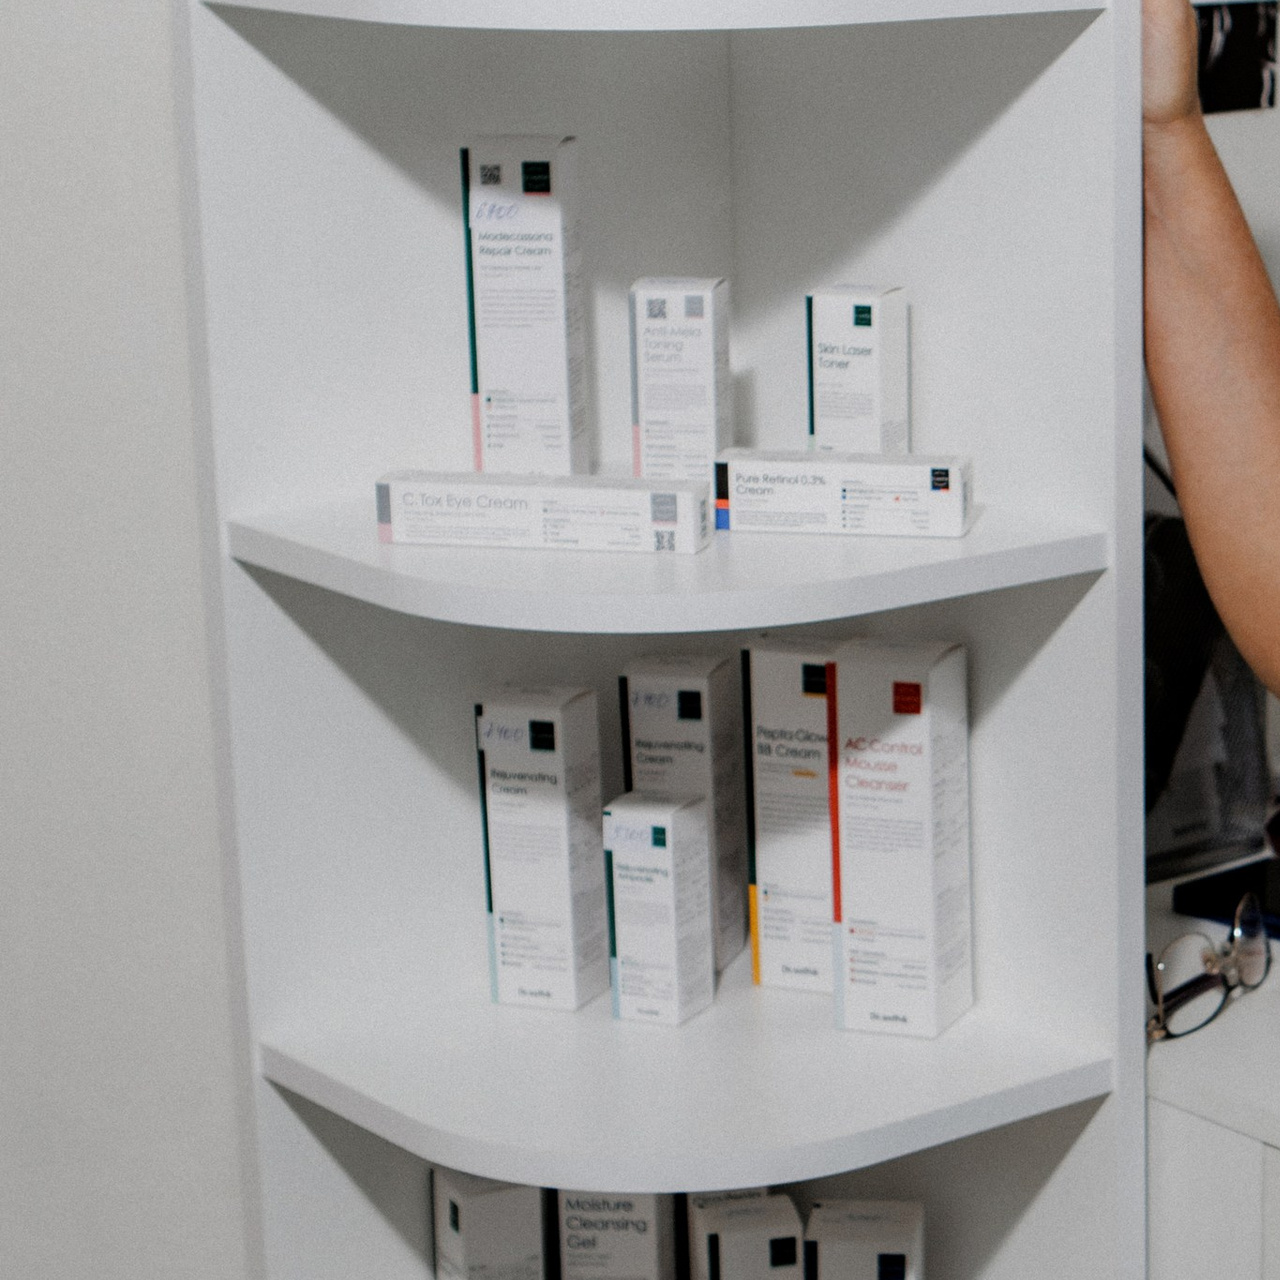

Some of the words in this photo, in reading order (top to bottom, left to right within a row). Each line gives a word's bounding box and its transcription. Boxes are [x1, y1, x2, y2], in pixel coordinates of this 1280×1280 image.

[515, 246, 551, 256] Cream
[818, 343, 838, 355] Skin
[842, 345, 872, 356] Laser
[818, 357, 850, 369] Toner
[736, 474, 759, 485] Pure
[762, 474, 799, 485] Retinol
[801, 475, 826, 486] 0.3%
[736, 485, 774, 496] Cream
[446, 494, 472, 509] Eye
[477, 495, 528, 510] Cream
[636, 739, 704, 752] Rejuvenating
[758, 743, 771, 756] BB
[775, 744, 821, 758] Cream
[636, 752, 673, 764] Cream
[845, 756, 899, 772] Mousse
[490, 769, 557, 785] Rejuvenating
[845, 774, 909, 792] Cleanser
[491, 783, 528, 795] Cream
[566, 1198, 633, 1213] Moisture
[566, 1216, 648, 1233] Cleansing
[567, 1234, 596, 1249] Gel
